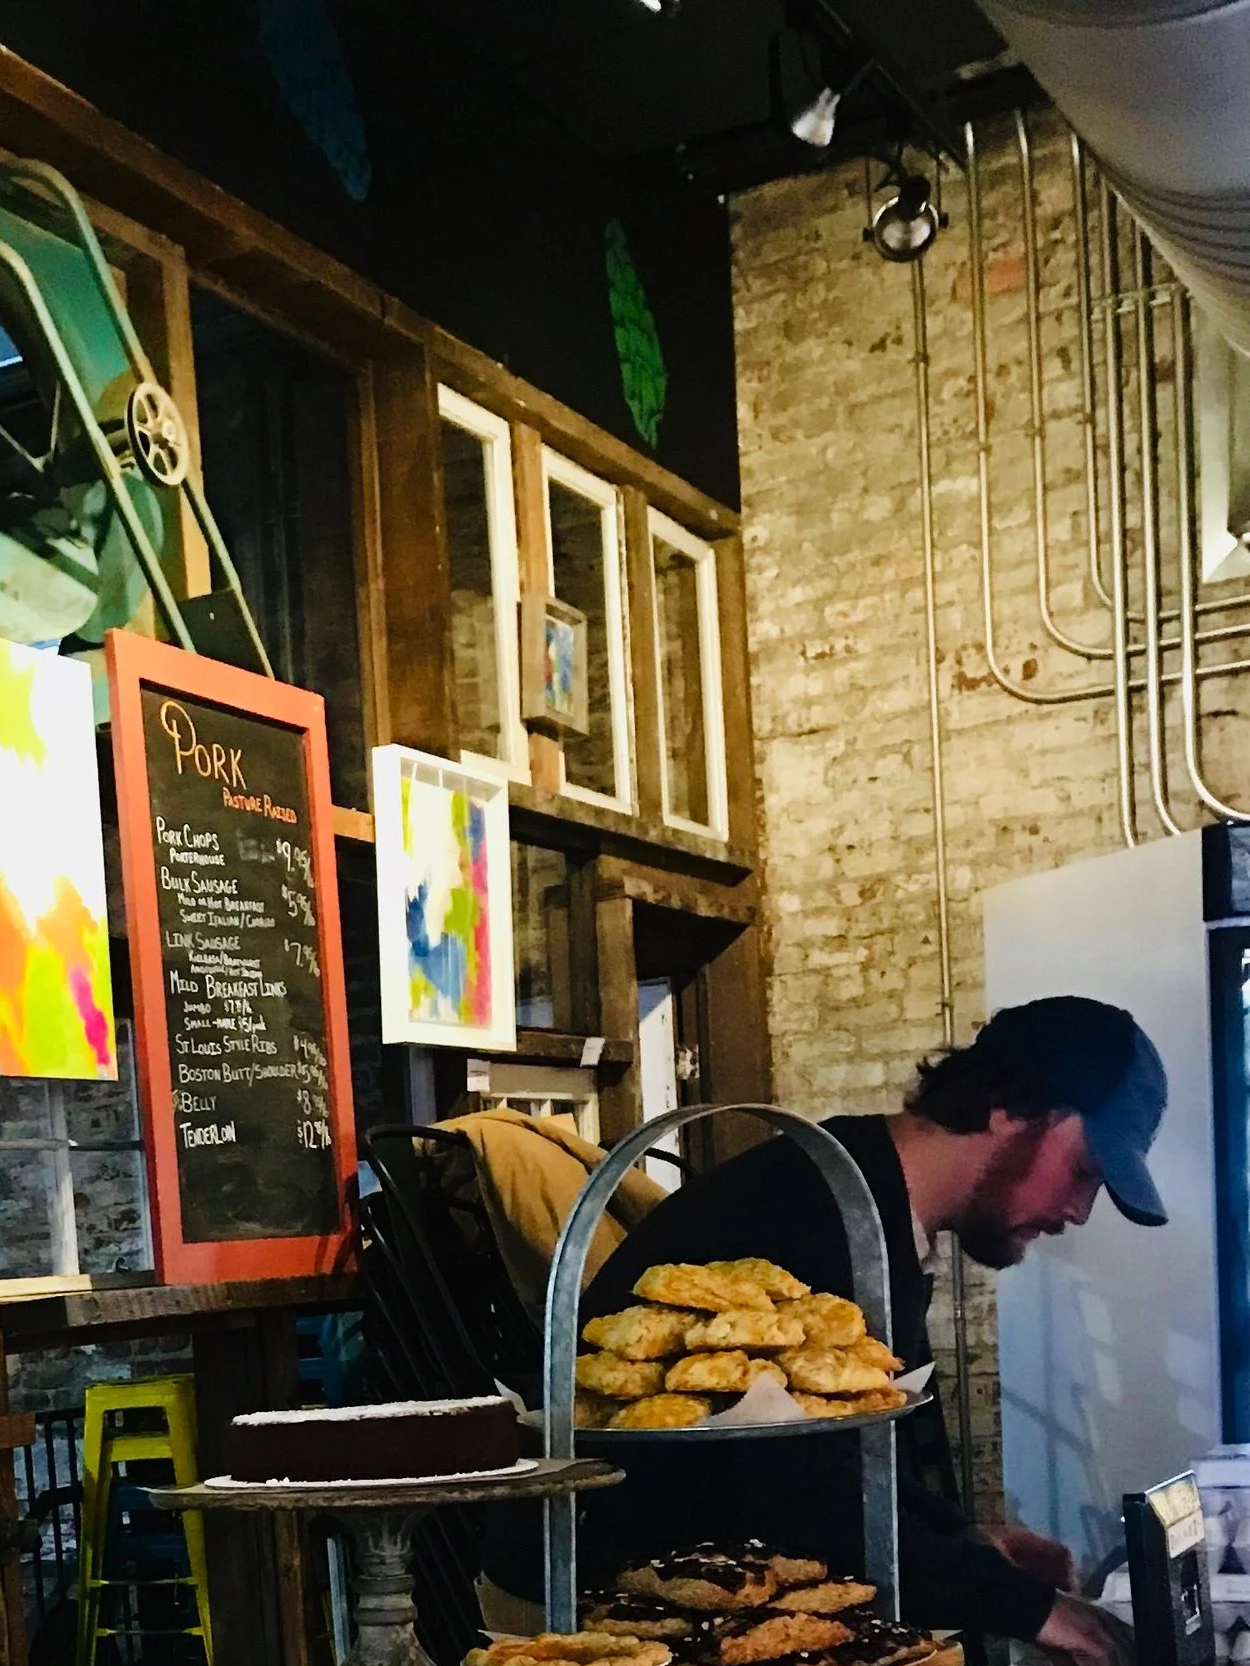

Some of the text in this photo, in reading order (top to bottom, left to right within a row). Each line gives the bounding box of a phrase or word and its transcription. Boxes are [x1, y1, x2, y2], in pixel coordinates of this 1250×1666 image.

[160, 700, 247, 790] PORK
[155, 815, 183, 847] PORK
[183, 823, 220, 851] CHOPS
[160, 865, 191, 893] BULK
[191, 870, 238, 895] SAUSAGE
[165, 930, 194, 949] LINK
[195, 931, 241, 951] SAUSAGE
[169, 969, 199, 995] MILD
[205, 974, 258, 999] BREAKFAST
[191, 1037, 222, 1056] LOUIS
[251, 1034, 278, 1054] RIBS
[178, 1063, 221, 1084] BOSTON
[181, 1092, 216, 1113] BELLY
